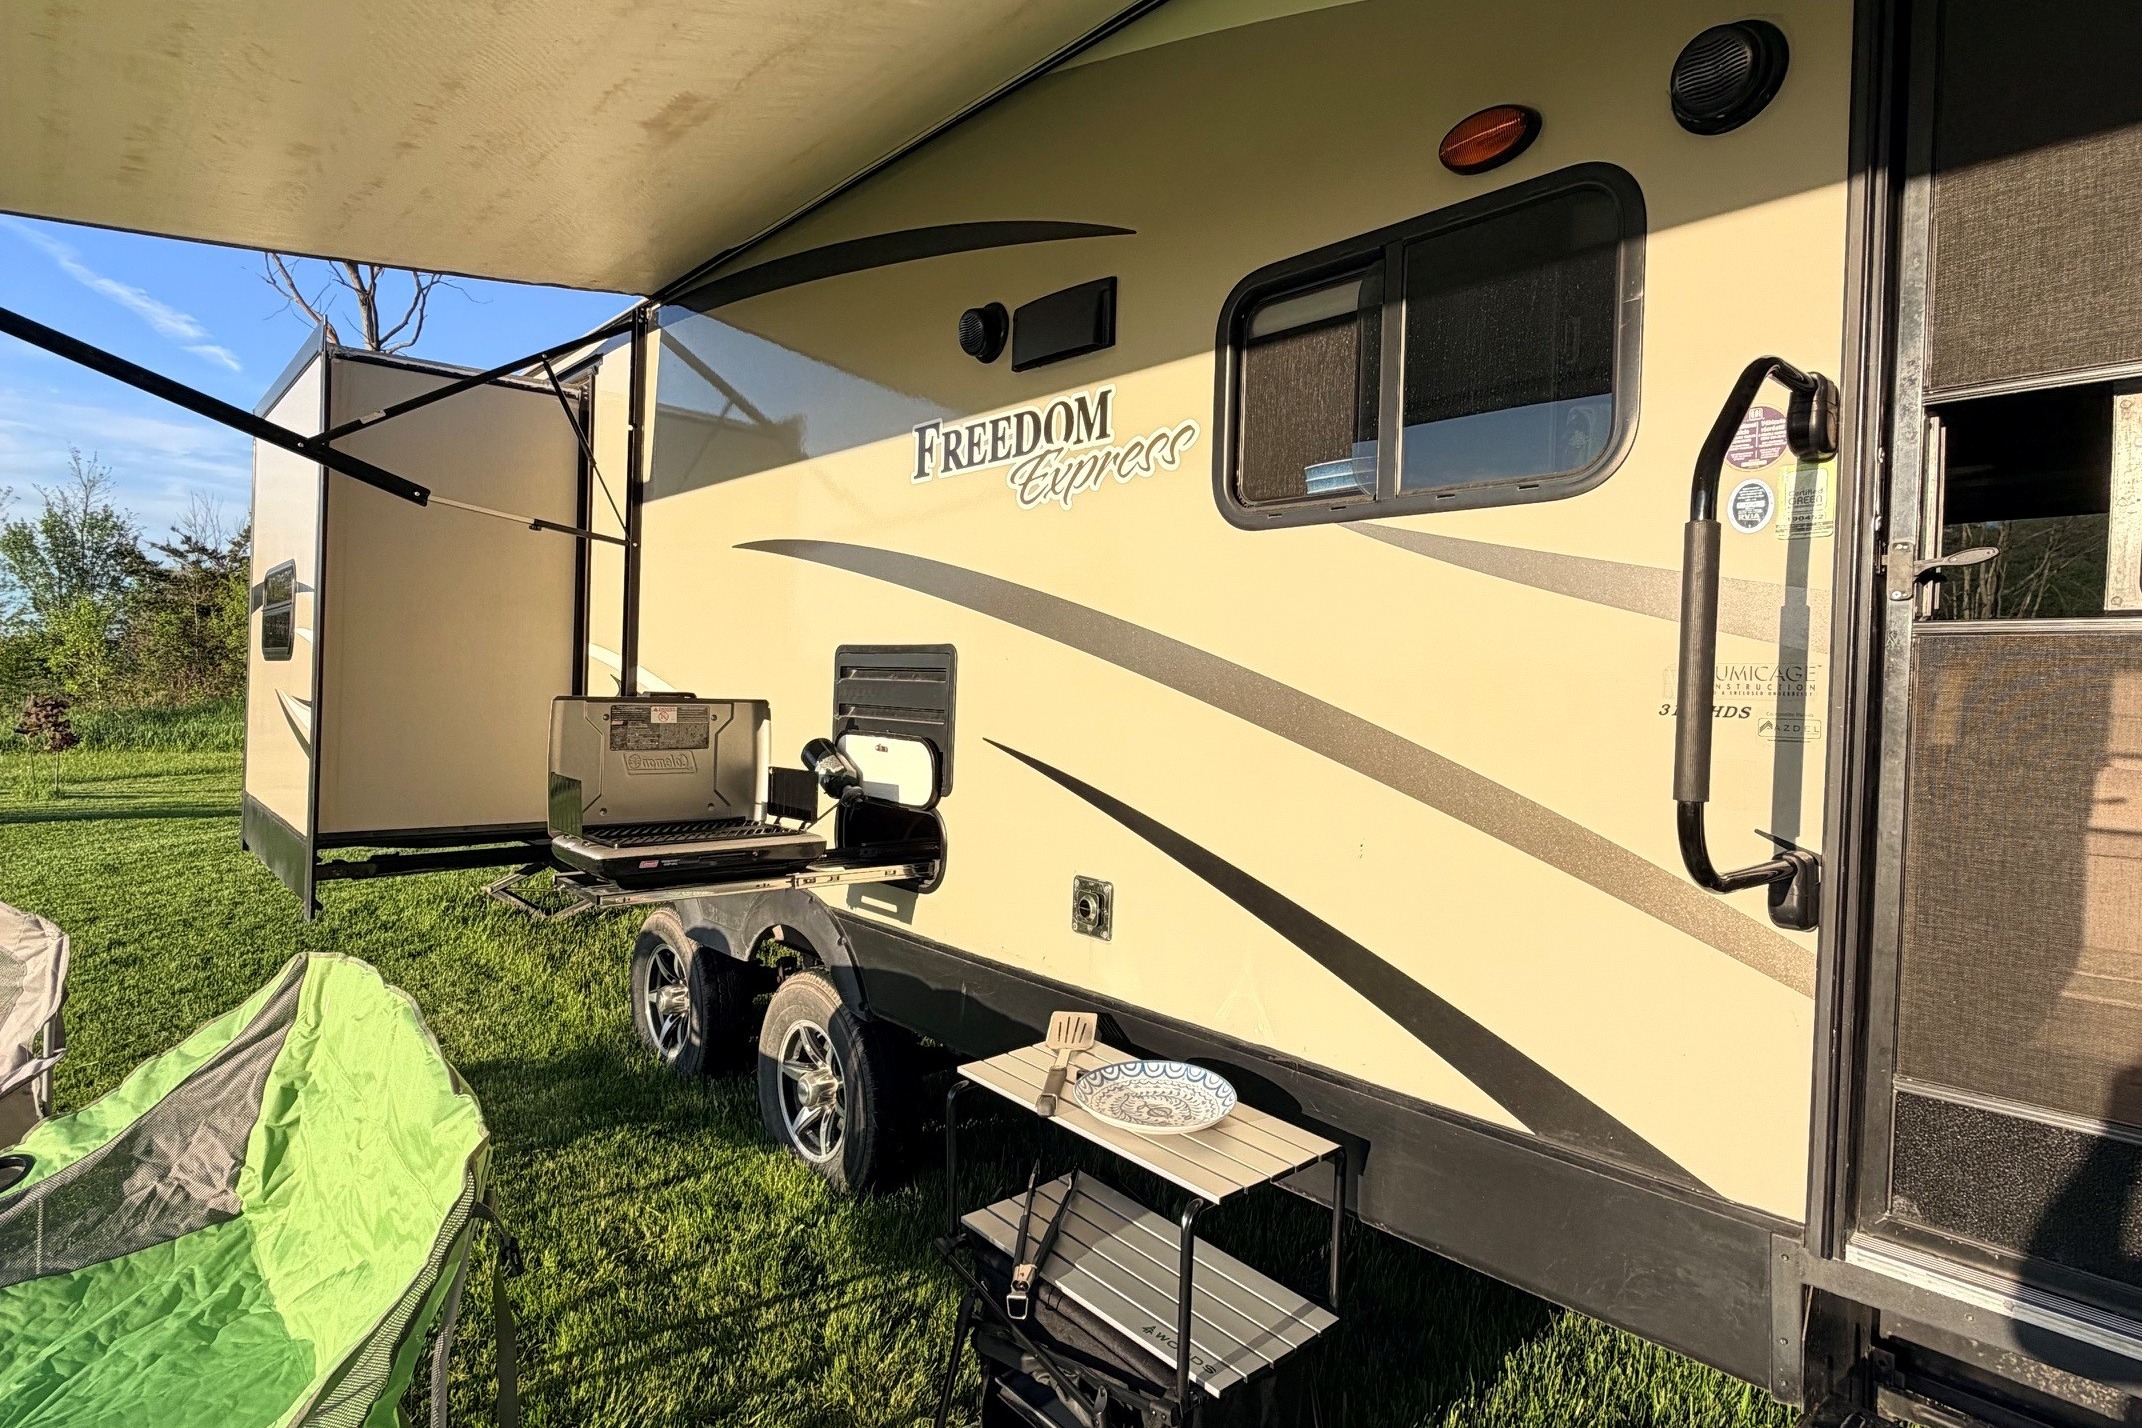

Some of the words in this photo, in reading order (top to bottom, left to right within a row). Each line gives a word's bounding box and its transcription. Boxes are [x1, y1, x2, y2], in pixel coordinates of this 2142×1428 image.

[913, 389, 1113, 480] FREEDOM
[1010, 424, 1196, 506] Express
[1714, 664, 1816, 682] UMICAGE
[1715, 683, 1816, 691] NSTRUCTION
[1659, 703, 1752, 719] 31HDS
[1156, 1331, 1217, 1375] WODS
